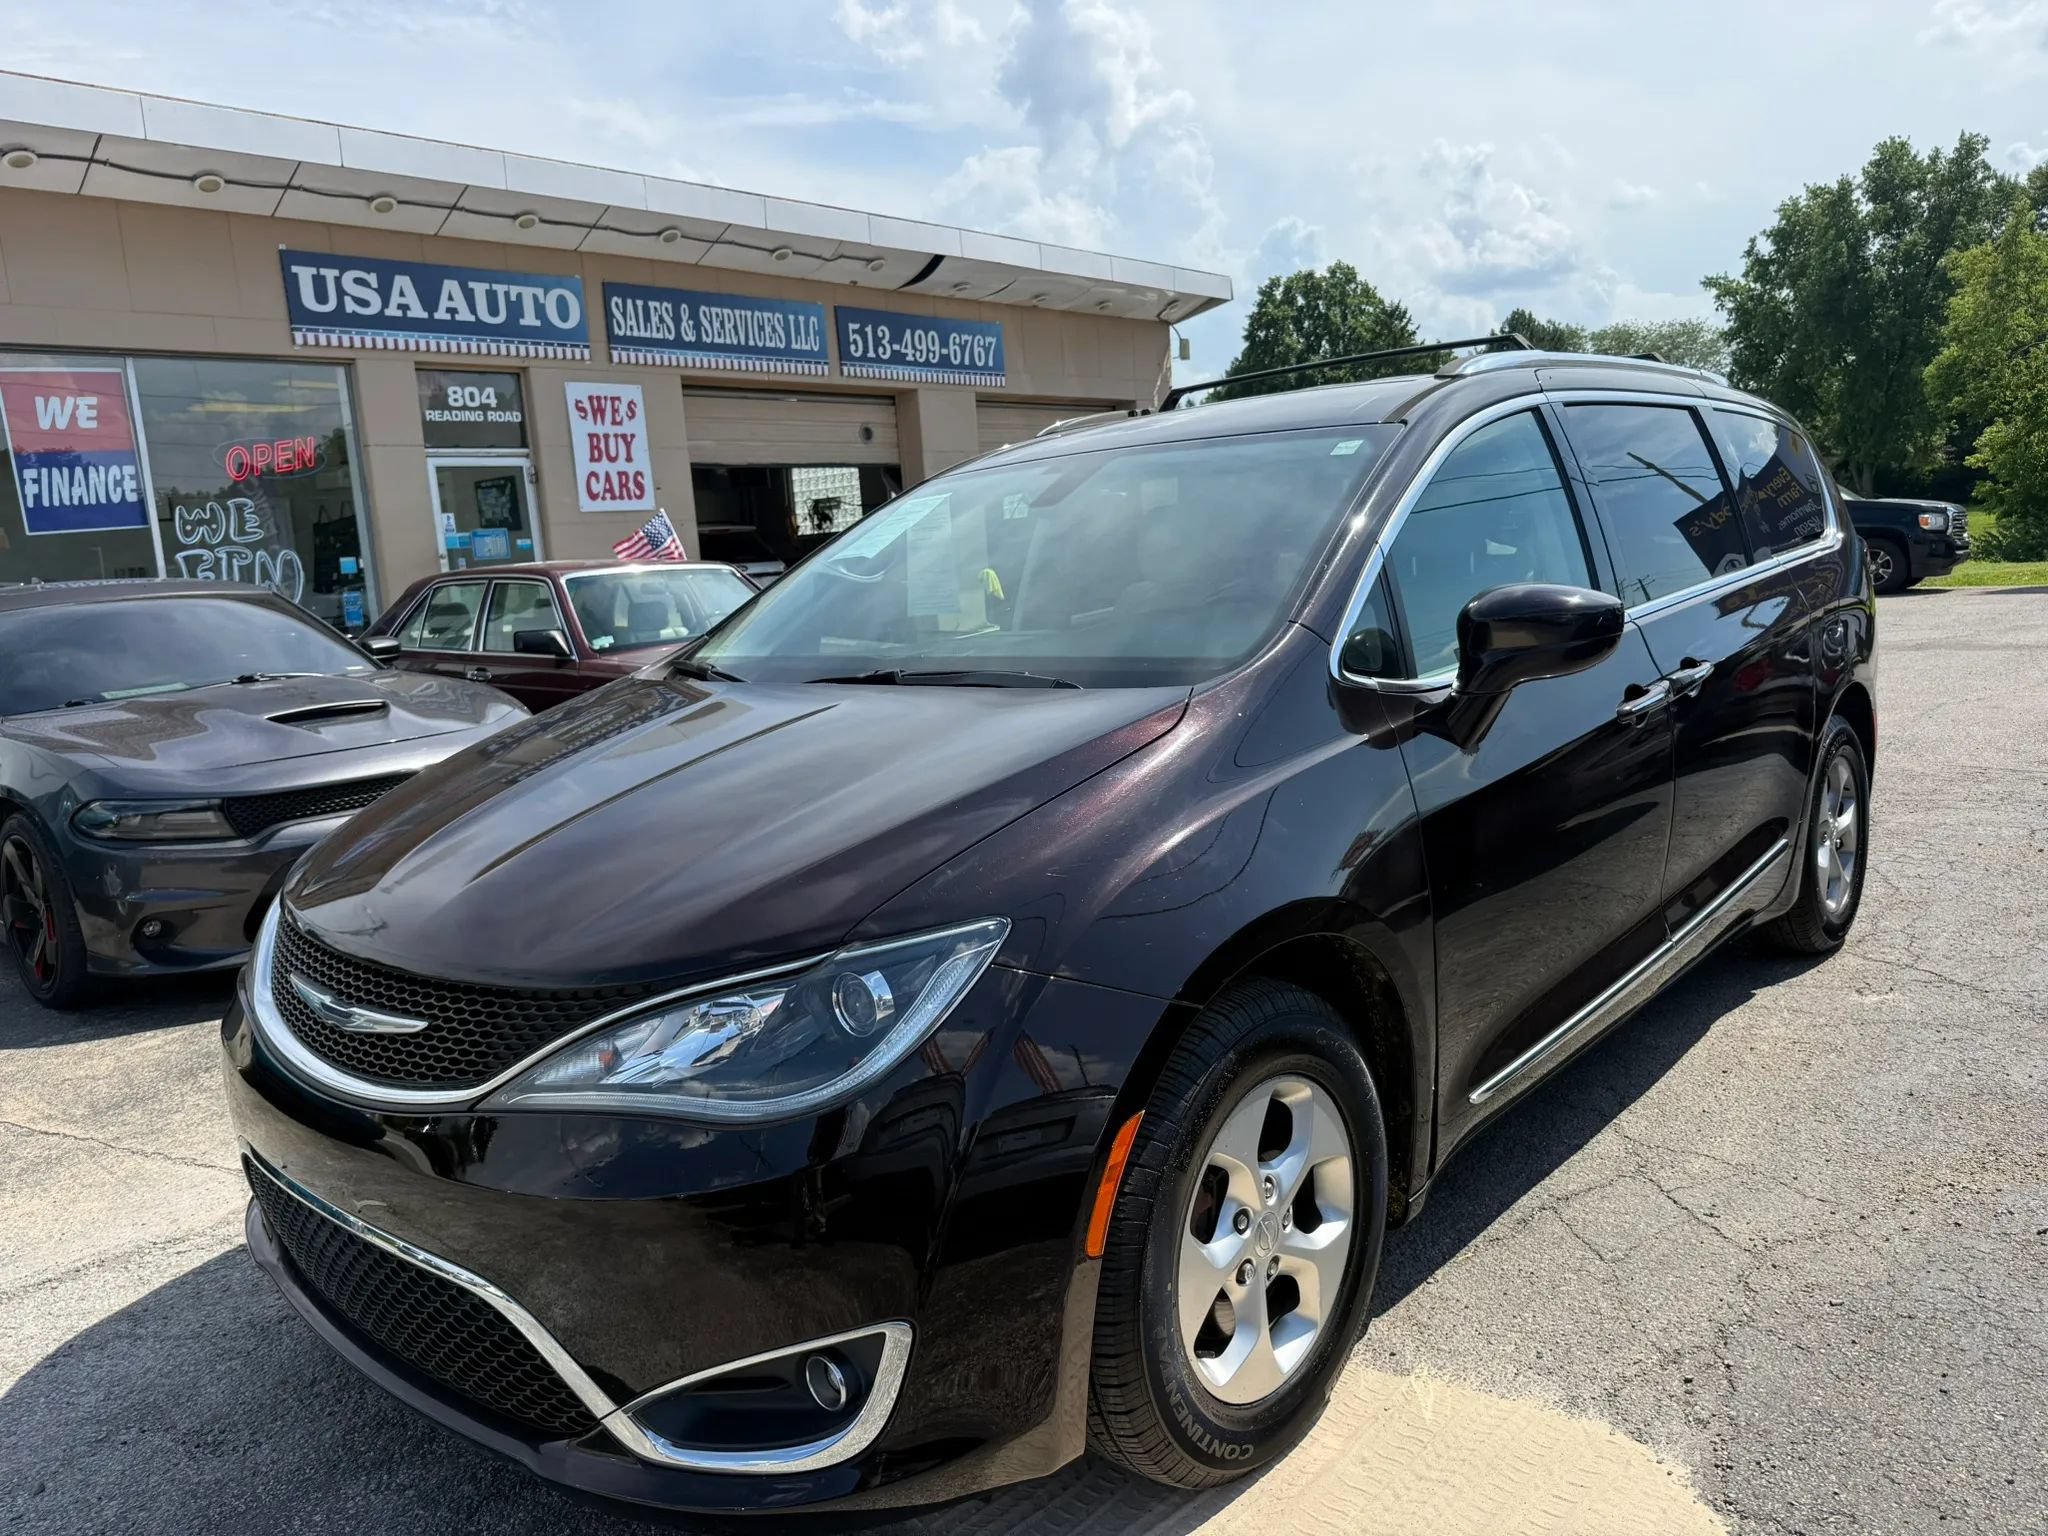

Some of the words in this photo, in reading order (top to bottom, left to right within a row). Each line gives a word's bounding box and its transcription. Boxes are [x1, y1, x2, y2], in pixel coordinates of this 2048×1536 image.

[291, 265, 428, 319] USA
[434, 279, 581, 330] AUTO
[611, 296, 675, 341] SALES
[680, 303, 696, 343] &
[700, 305, 786, 349] SERVICES
[788, 314, 820, 352] LLC
[848, 322, 997, 367] 513-499-6767
[35, 396, 98, 431] WE
[425, 410, 484, 422] READING
[488, 411, 522, 423] ROAD
[447, 386, 498, 408] 804
[225, 436, 316, 482] OPEN
[587, 432, 636, 464] BUY
[23, 464, 139, 509] FINANCE
[586, 470, 646, 502] CARS
[175, 498, 265, 545] WE
